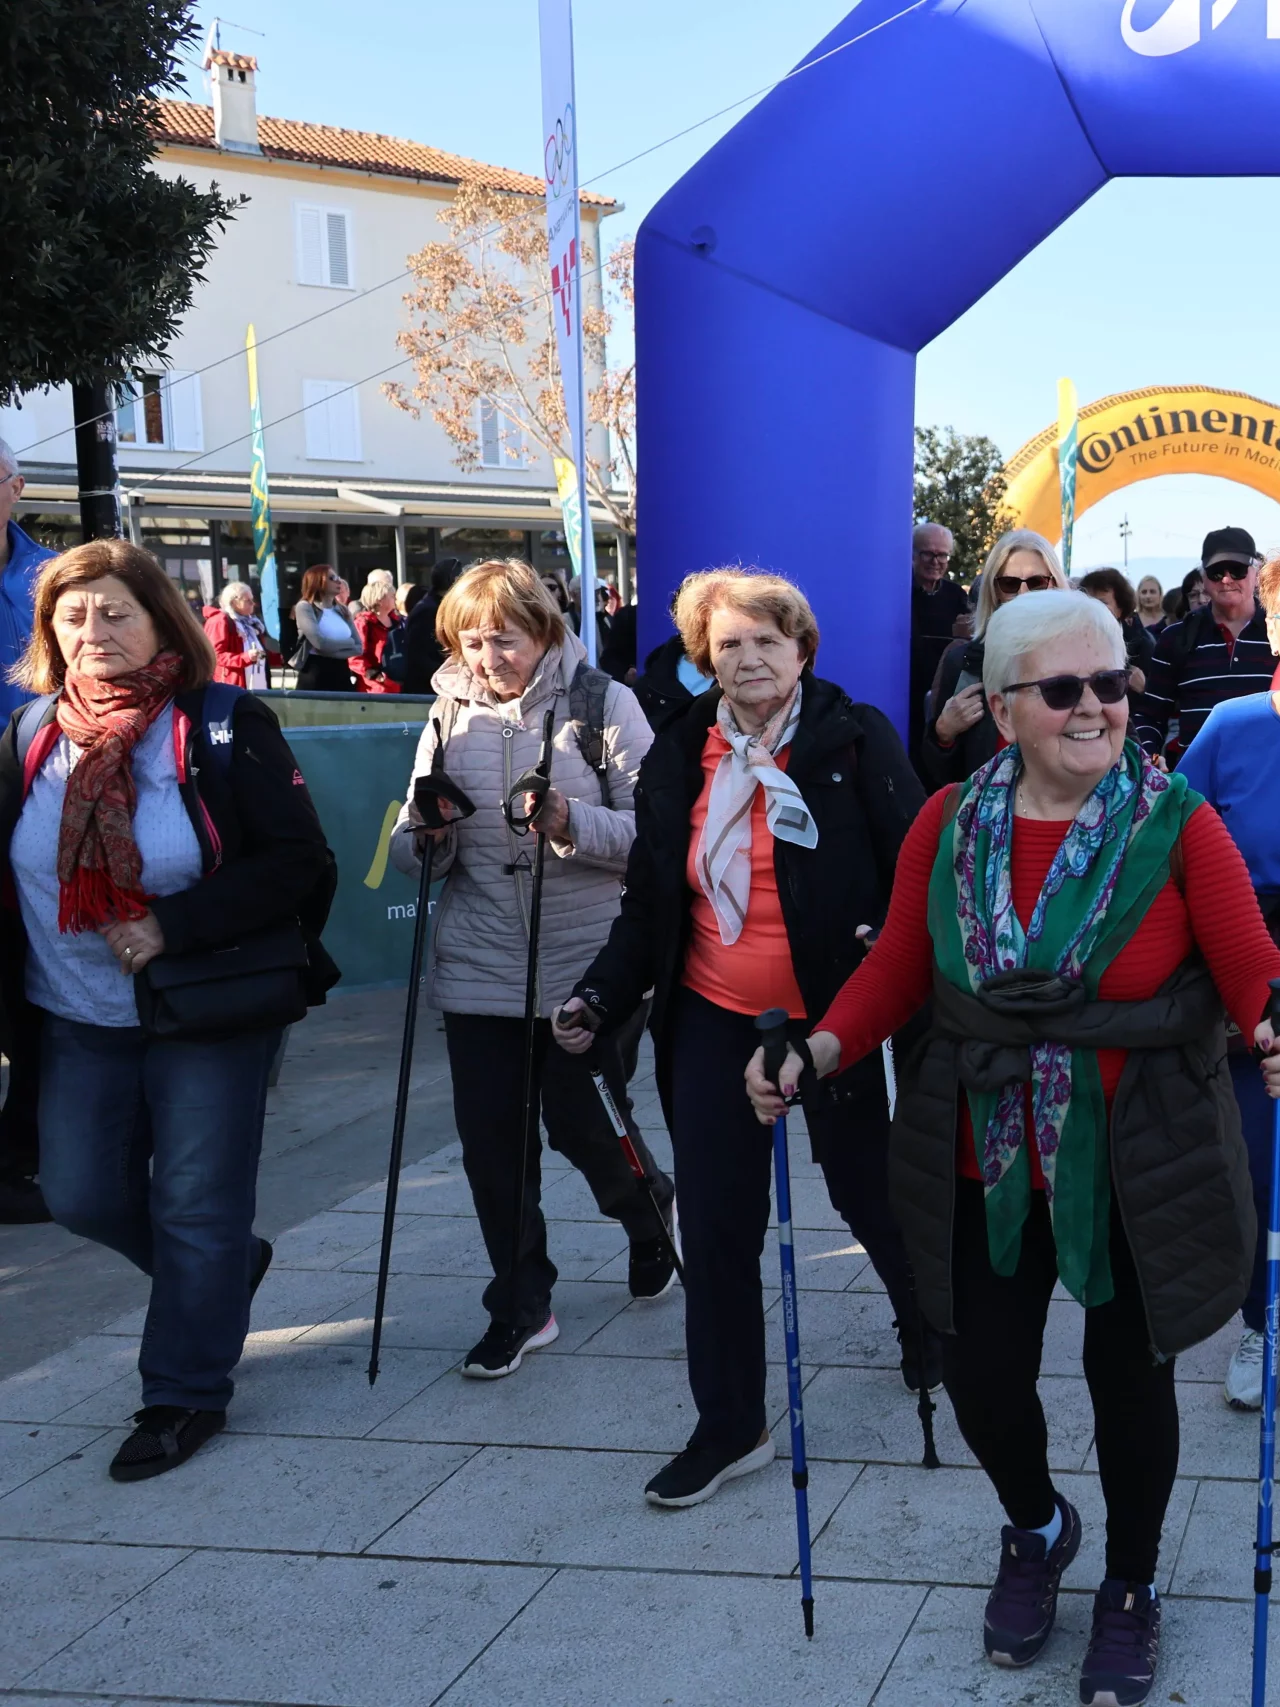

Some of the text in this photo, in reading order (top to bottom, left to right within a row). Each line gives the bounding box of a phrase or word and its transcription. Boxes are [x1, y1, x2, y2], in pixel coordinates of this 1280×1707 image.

[1129, 448, 1158, 466] The
[1162, 441, 1219, 456] Future
[1224, 442, 1240, 457] in
